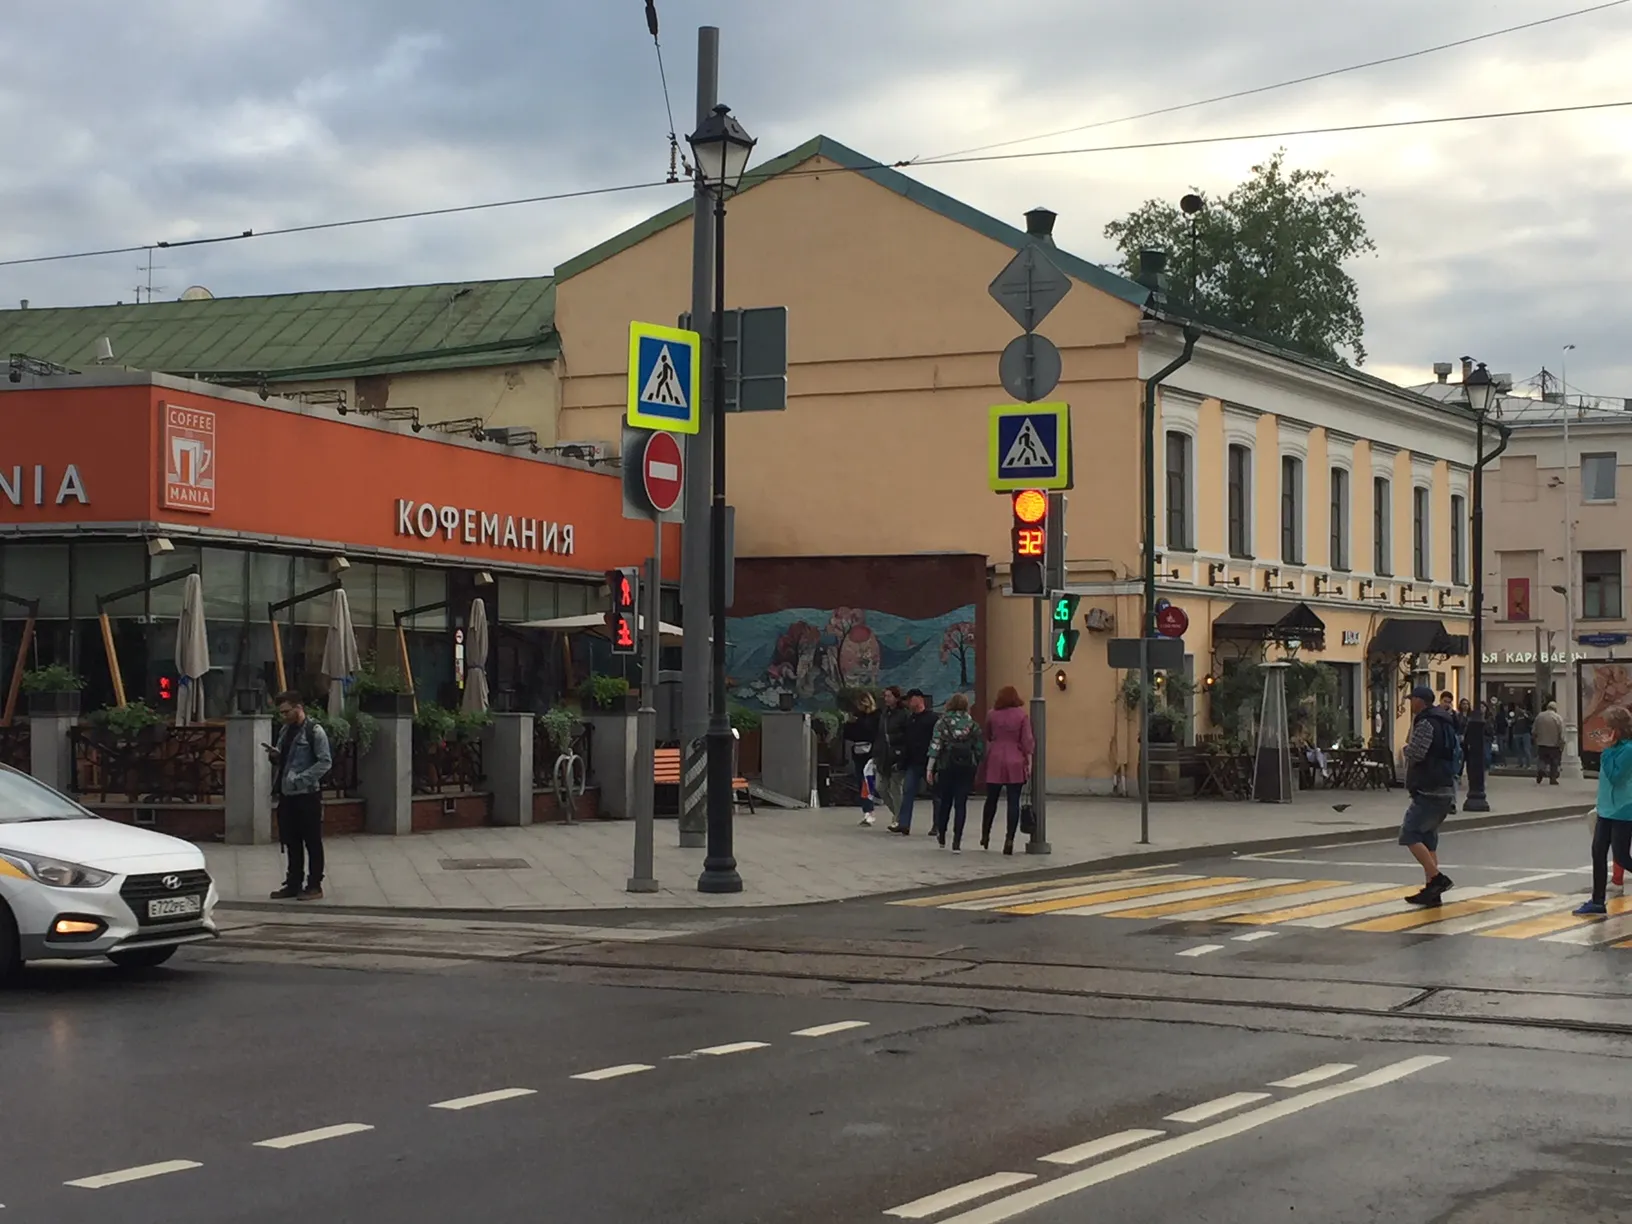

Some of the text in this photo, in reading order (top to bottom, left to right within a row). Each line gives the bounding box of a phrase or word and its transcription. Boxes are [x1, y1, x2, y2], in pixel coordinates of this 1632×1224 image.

[170, 410, 212, 430] COFFEE
[170, 486, 210, 504] MANIA
[398, 499, 574, 555] КОФЕМАНИЯ
[1018, 530, 1042, 554] 32
[1054, 599, 1069, 620] 26
